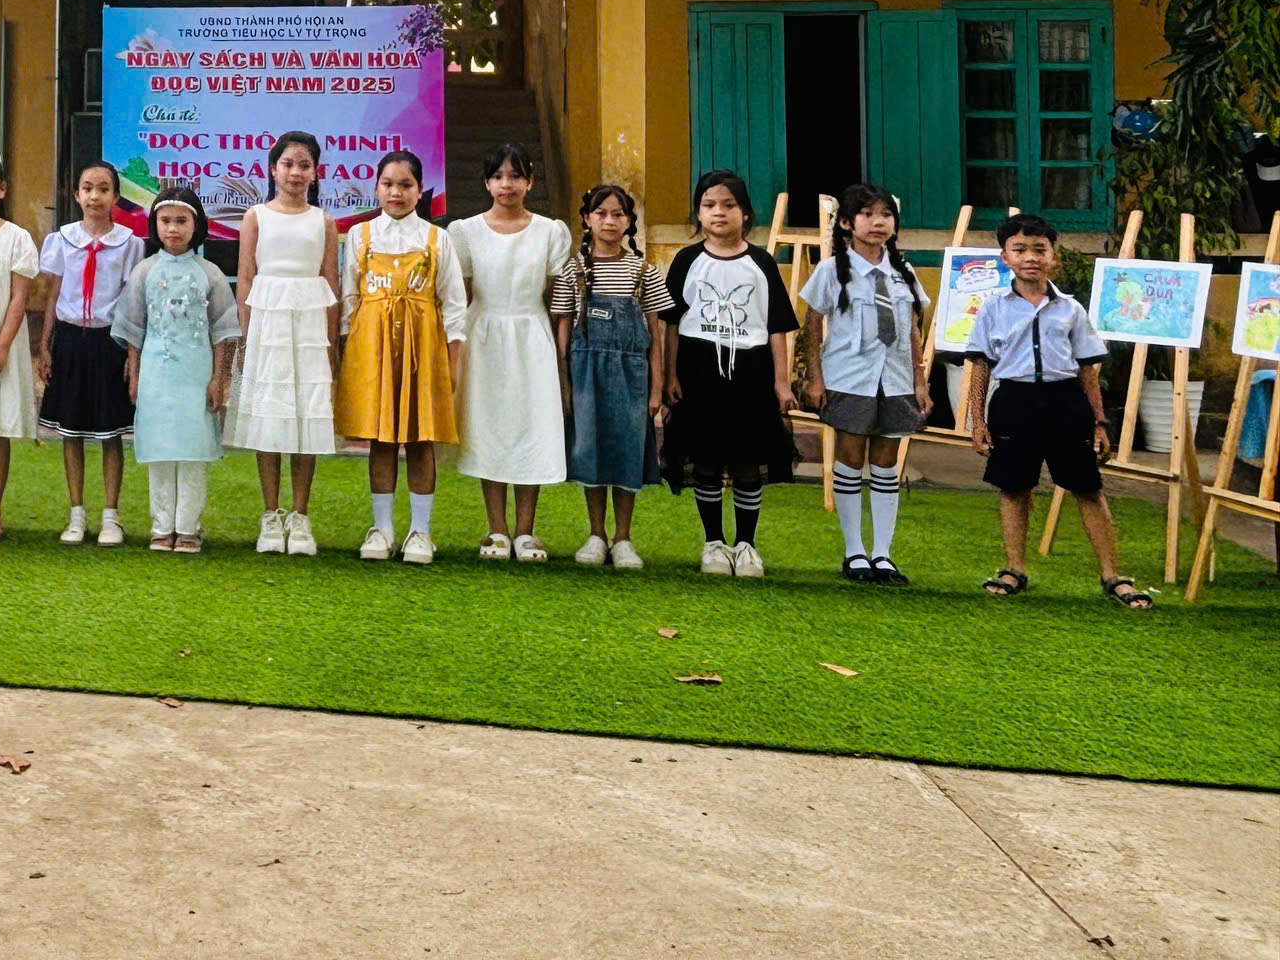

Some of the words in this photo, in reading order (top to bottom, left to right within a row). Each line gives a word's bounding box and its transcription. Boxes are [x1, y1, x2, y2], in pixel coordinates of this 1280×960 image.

[200, 16, 232, 26] UBND
[236, 14, 274, 26] THÀNH
[328, 16, 344, 26] AN
[260, 27, 285, 39] HỌC
[305, 28, 322, 39] TỰ
[325, 28, 367, 39] TRỌNG
[126, 49, 195, 69] NGÀY
[199, 49, 267, 69] SÁCH
[271, 49, 306, 69] VÀ
[309, 49, 362, 69] VĂN
[151, 75, 202, 96] ĐỌC
[206, 73, 261, 96] VIỆT
[265, 76, 325, 94] NAM
[331, 76, 395, 94] 2025
[215, 130, 278, 151] THÔ
[158, 160, 222, 181] HỌC
[227, 158, 266, 179] SÁ
